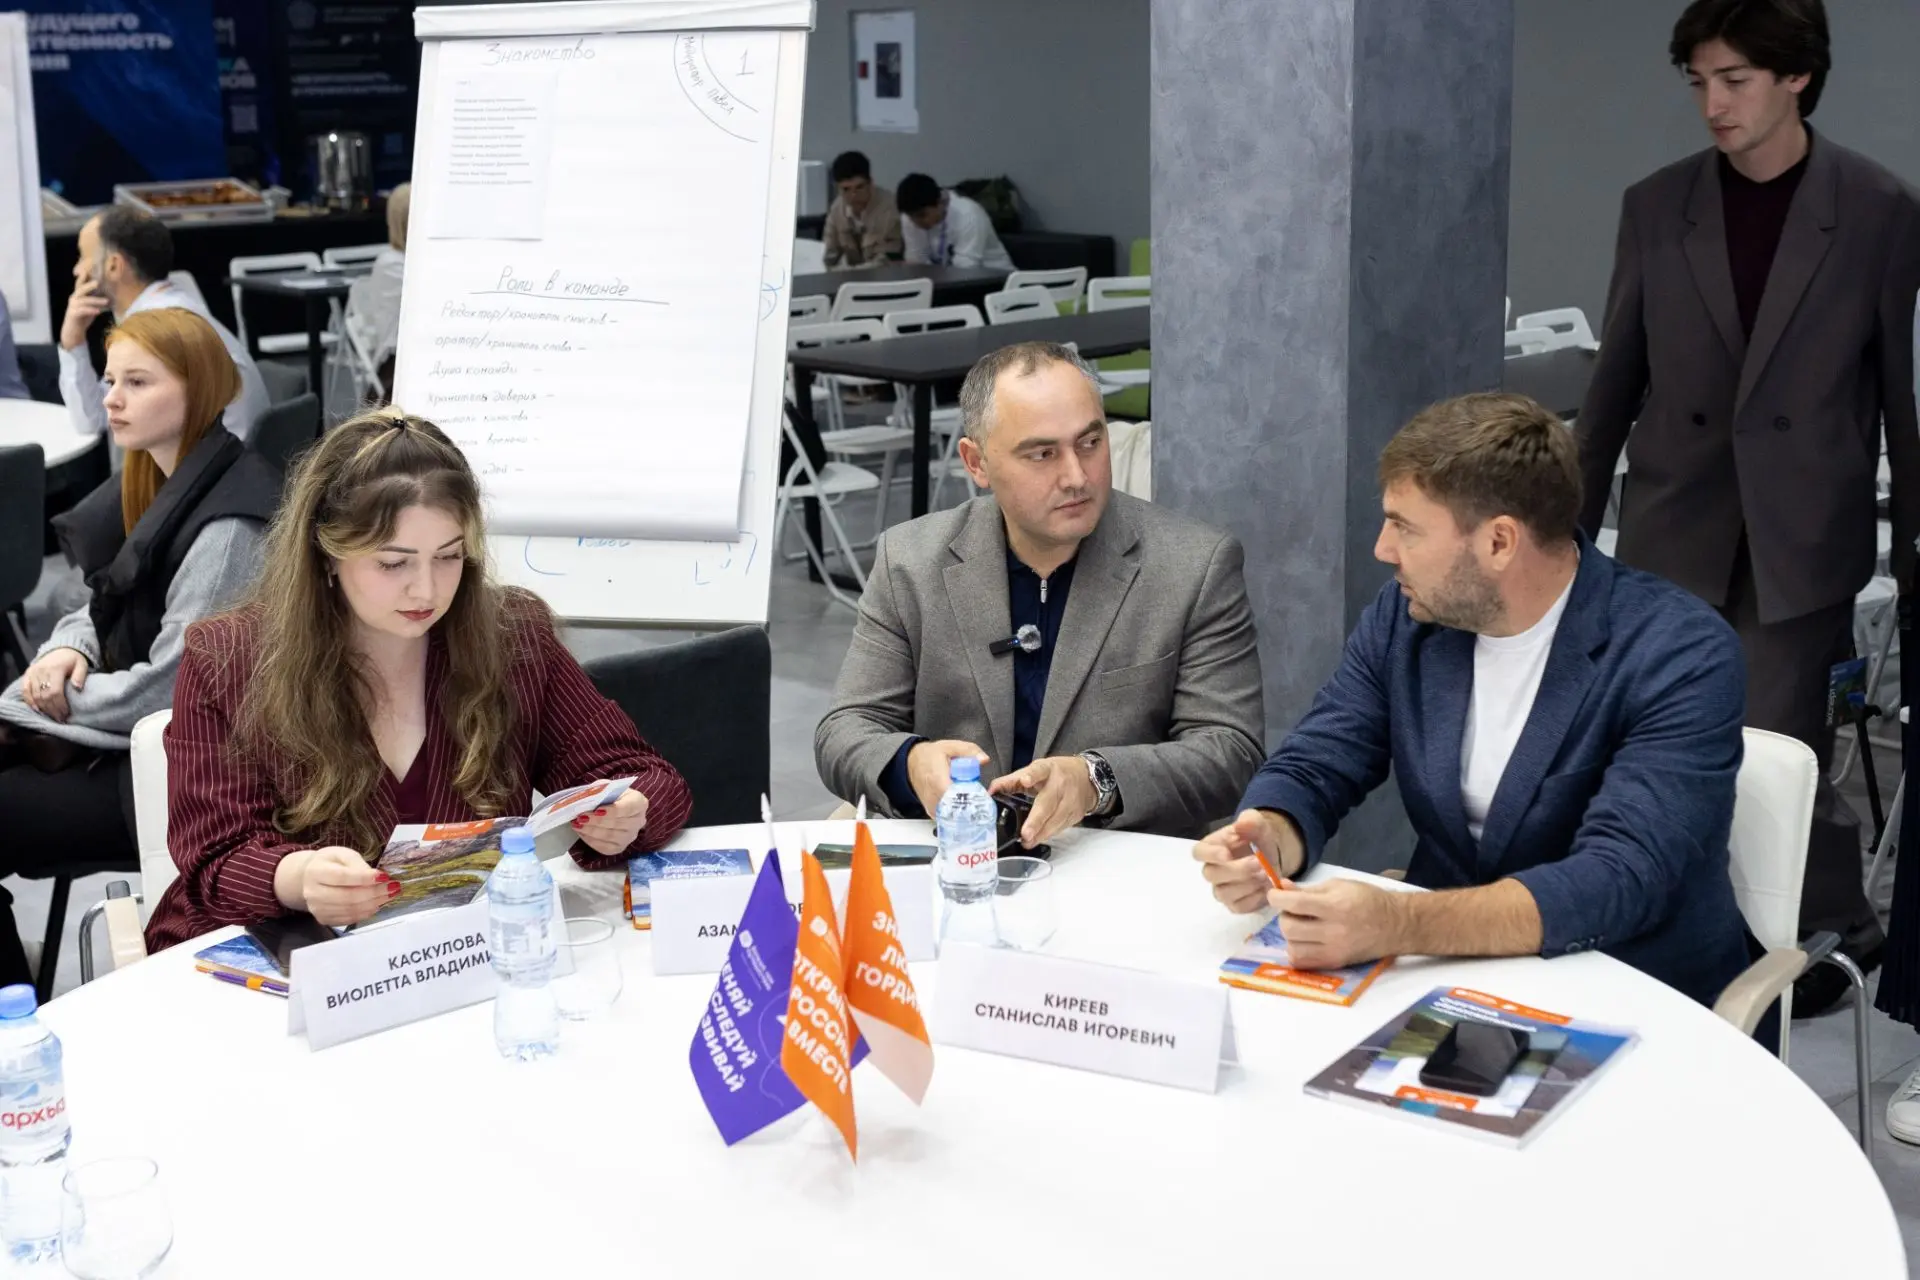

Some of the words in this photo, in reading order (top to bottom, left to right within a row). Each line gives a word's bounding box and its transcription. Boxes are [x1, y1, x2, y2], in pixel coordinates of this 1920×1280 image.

[482, 38, 596, 66] Знакомство
[496, 264, 534, 292] Роли
[544, 269, 561, 291] в
[563, 276, 631, 297] команде
[388, 931, 487, 971] КАСКУЛОВА
[880, 944, 909, 975] ЛЮ
[326, 973, 412, 1010] ВИОЛЕТТА
[415, 949, 493, 984] ВЛАДИМИ
[721, 957, 754, 1018] ЕНЯЙ
[790, 984, 850, 1069] РОССИ
[974, 1002, 1079, 1033] СТАНИСЛАВ
[1084, 1020, 1177, 1050] ИГОРЕВИЧ
[1043, 992, 1110, 1016] КИРЕЕВ
[701, 1013, 746, 1093] ЗВИВАЙ
[711, 989, 758, 1070] СЛЕДУЙ
